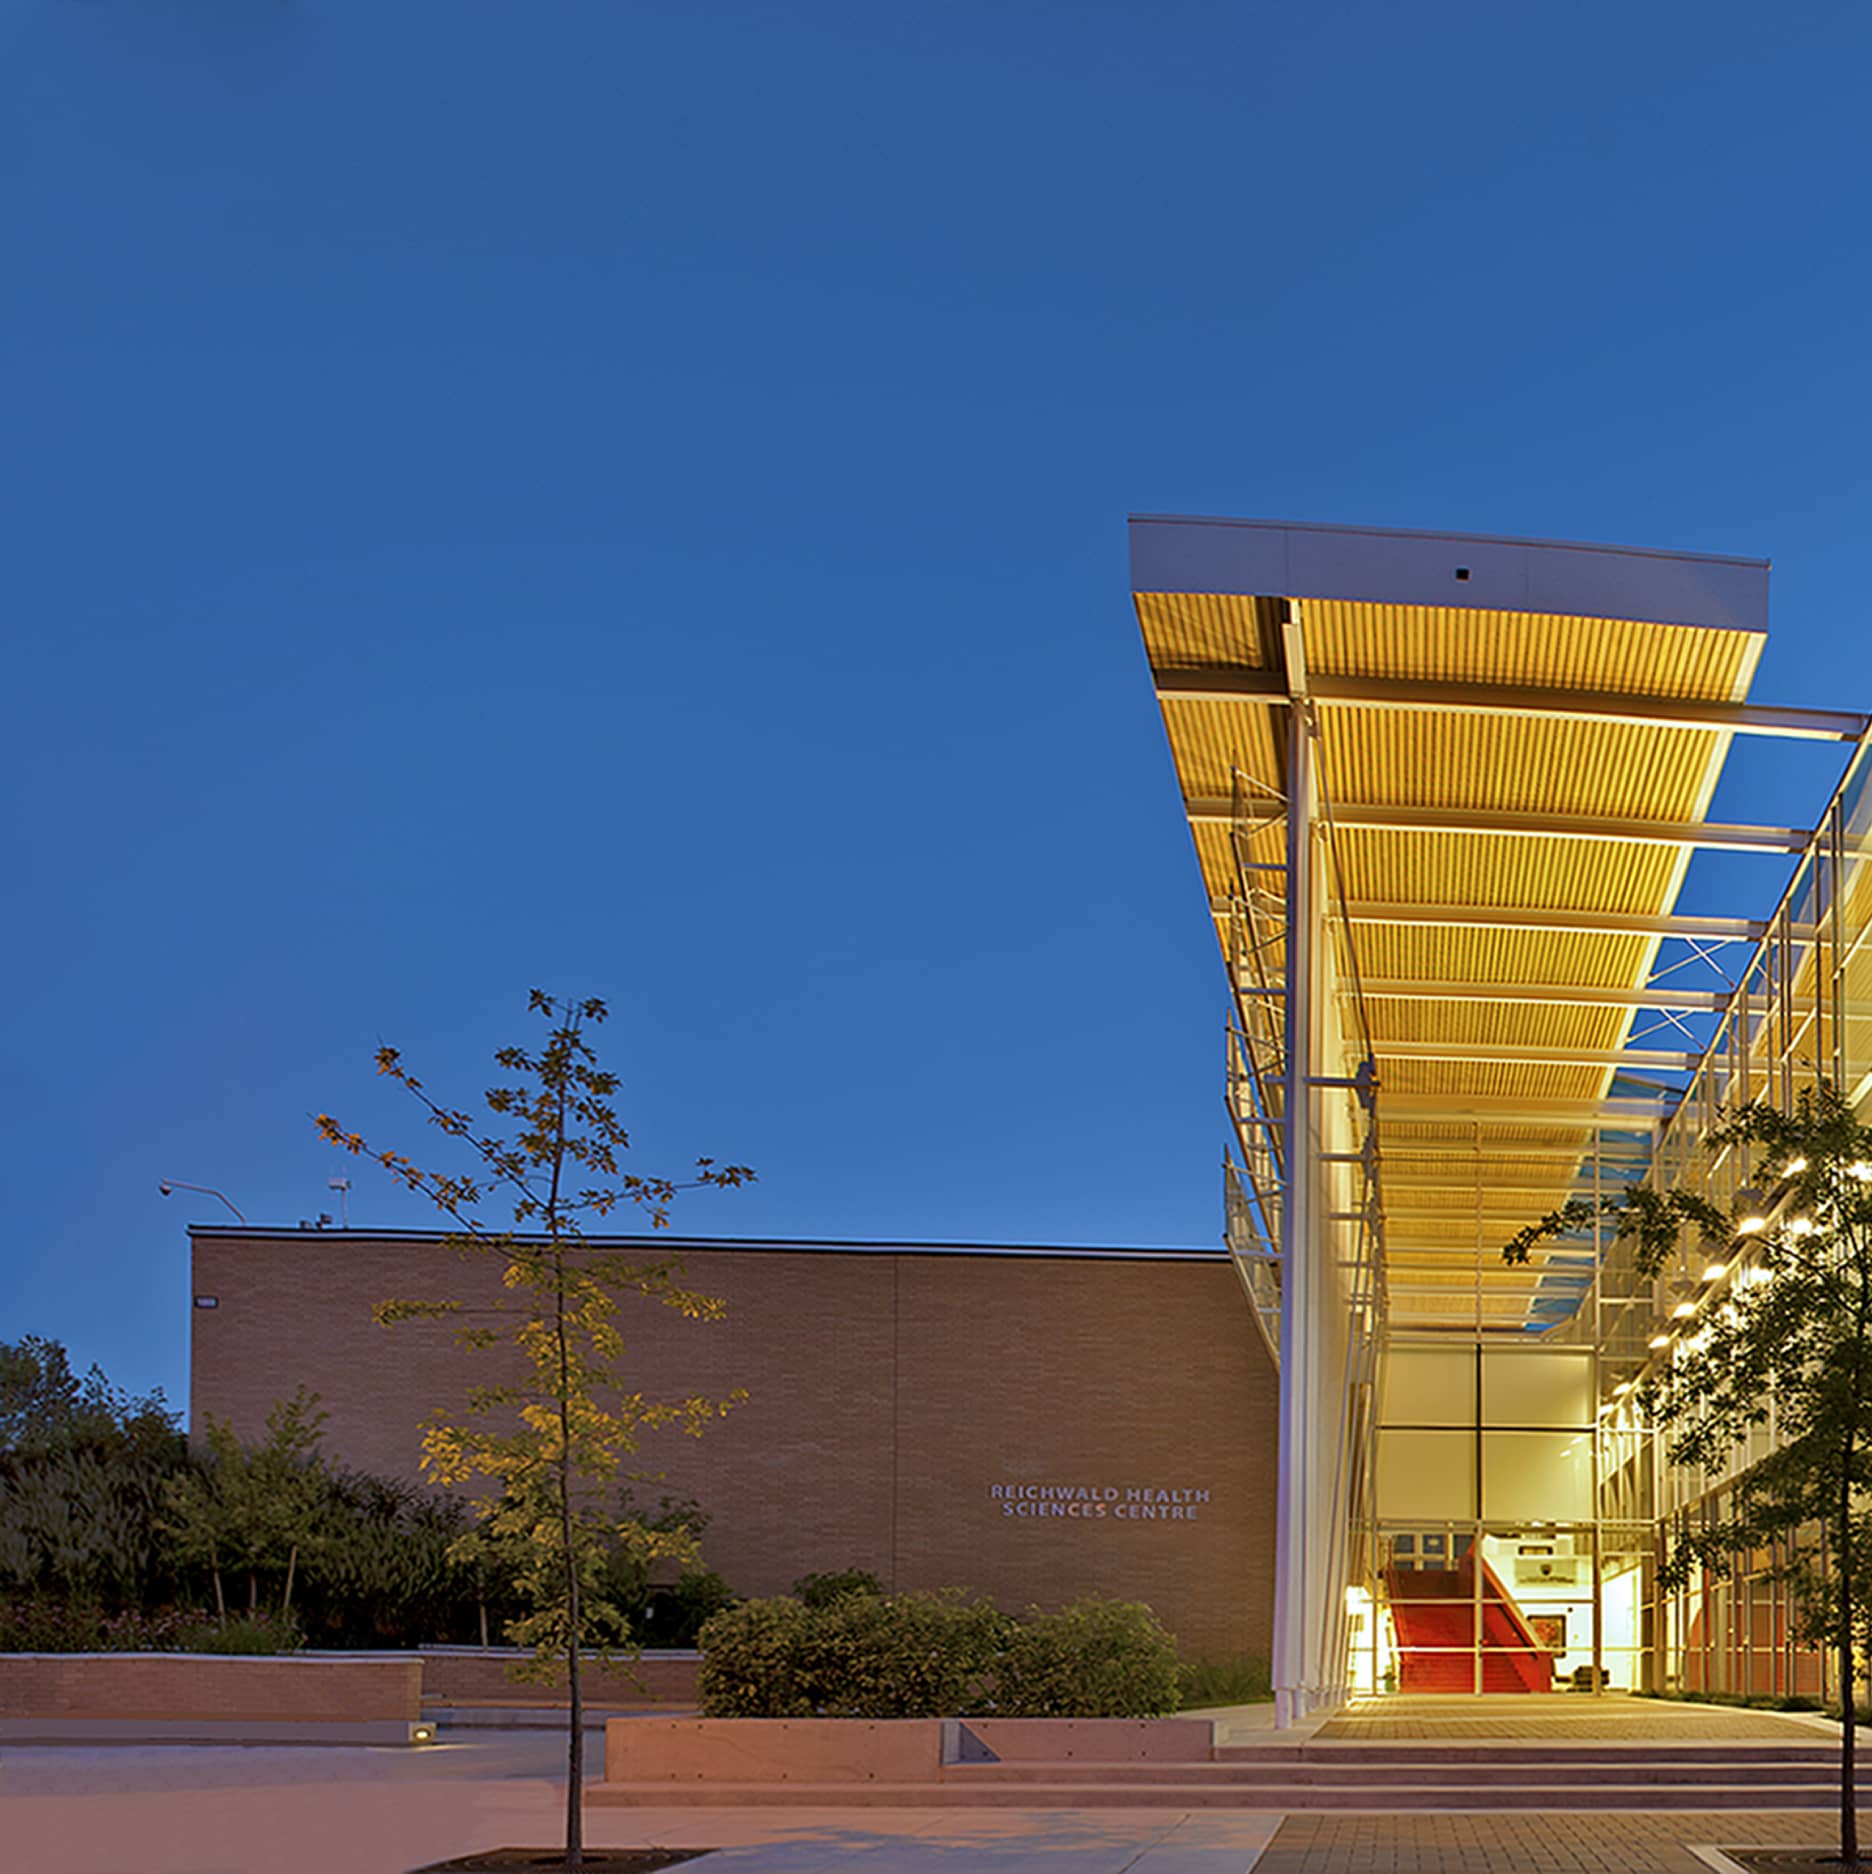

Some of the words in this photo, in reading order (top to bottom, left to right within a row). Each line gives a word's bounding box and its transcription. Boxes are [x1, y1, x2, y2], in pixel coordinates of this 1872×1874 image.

[991, 1484, 1119, 1501] REICHWALD
[1126, 1488, 1210, 1503] HEALTH
[1003, 1502, 1107, 1517] SCIENCES
[1114, 1504, 1198, 1520] CENTRE
